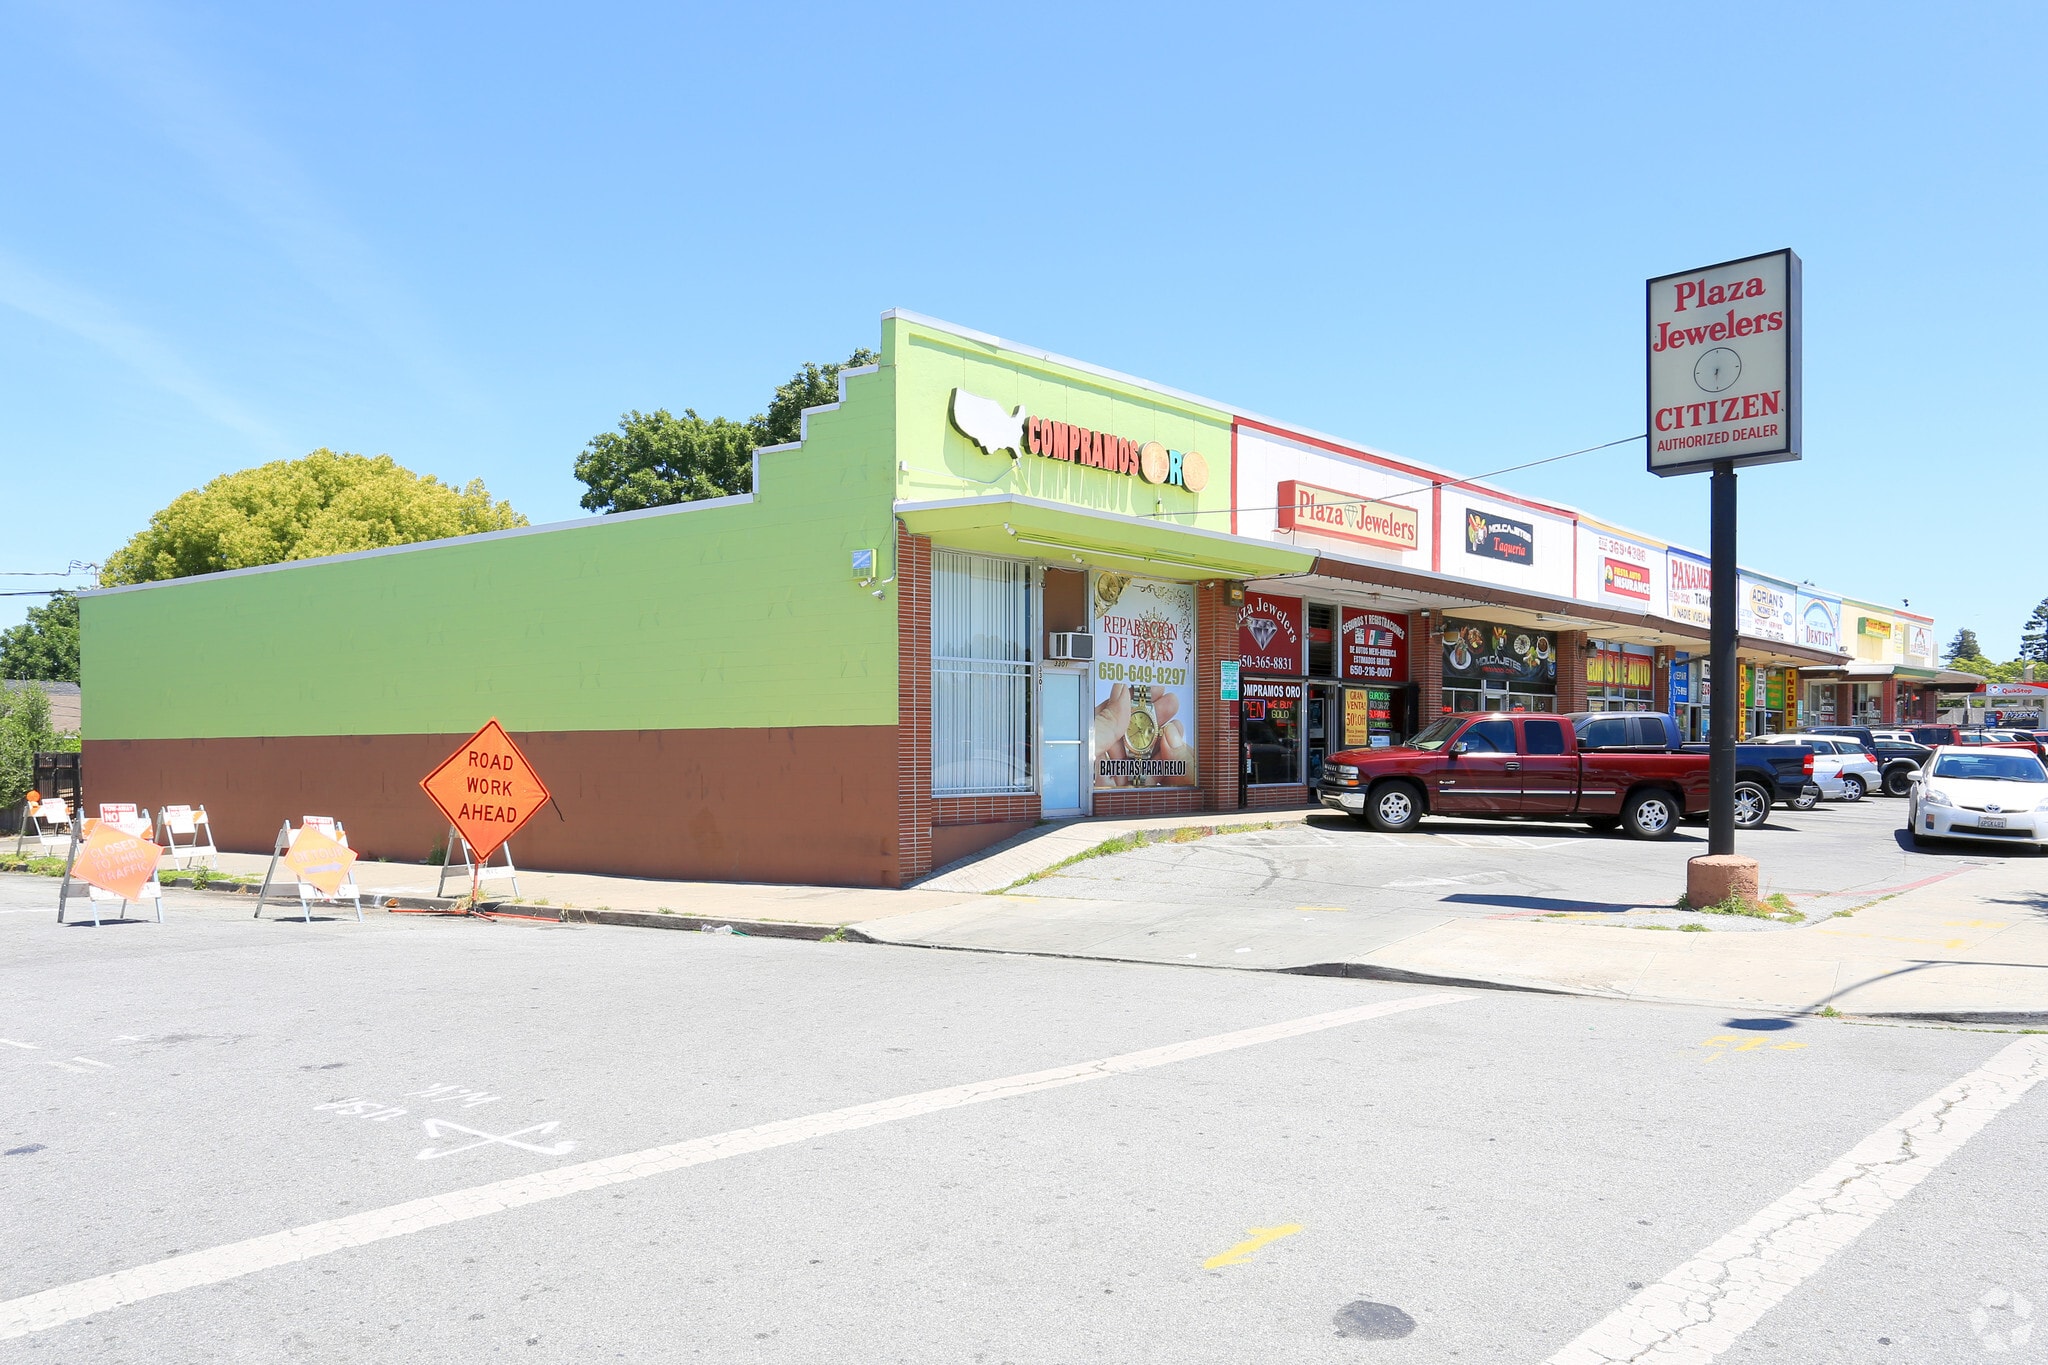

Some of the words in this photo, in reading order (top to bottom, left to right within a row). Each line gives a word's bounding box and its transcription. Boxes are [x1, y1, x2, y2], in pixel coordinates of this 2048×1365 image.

[1674, 277, 1766, 312] Plaza
[1653, 309, 1783, 352] Jewelers
[1655, 390, 1781, 432] CITIZEN
[1026, 415, 1139, 476] COMPRAMOS
[1657, 431, 1729, 452] AUTHORIZED
[1732, 424, 1778, 441] DEALER
[1298, 490, 1344, 526] Plaza
[1356, 504, 1414, 541] Jewelers
[1488, 523, 1532, 543] MOLCAJETES
[1493, 536, 1526, 557] Taqueria
[1613, 566, 1629, 577] FIESTA
[1629, 570, 1642, 581] AUTO
[1613, 575, 1650, 595] INSURANCE
[1694, 592, 1710, 607] TRAV
[1752, 588, 1784, 609] ADRIAN'S
[1256, 597, 1297, 643] Jewelers
[1757, 605, 1770, 616] INCOME
[1103, 615, 1178, 641] REPARACION
[1342, 615, 1364, 634] SEGUROS
[1364, 614, 1368, 625] Y
[1368, 614, 1405, 640] REGISTRACIONES
[1806, 625, 1833, 647] DENTIST
[1108, 635, 1128, 657] DE
[1131, 638, 1174, 662] JOYAS
[1350, 645, 1355, 654] DE
[1099, 662, 1186, 686] 650-649-8297
[1350, 664, 1393, 678] 650-216-0007
[1475, 655, 1521, 672] MOLCAJETES
[1628, 656, 1651, 688] AUTO
[1285, 685, 1301, 698] ORO
[1350, 690, 1364, 701] GRAN
[1786, 671, 1795, 717] INCOME
[2002, 687, 2033, 695] QuikStop
[1267, 700, 1277, 709] WE
[1279, 700, 1293, 709] BUY
[1271, 709, 1290, 719] GOLD
[469, 751, 514, 771] ROAD
[1100, 760, 1140, 776] BATERIAS
[1142, 760, 1163, 776] PARA
[1165, 760, 1186, 776] RELOJ
[466, 776, 513, 797] WORK
[104, 812, 119, 822] NO
[458, 802, 517, 823] AHEAD
[89, 838, 137, 859] CLOSED
[292, 846, 344, 864] DETOUR
[92, 858, 111, 872] TO
[112, 847, 146, 864] THRU
[98, 860, 149, 883] TRAFFIC
